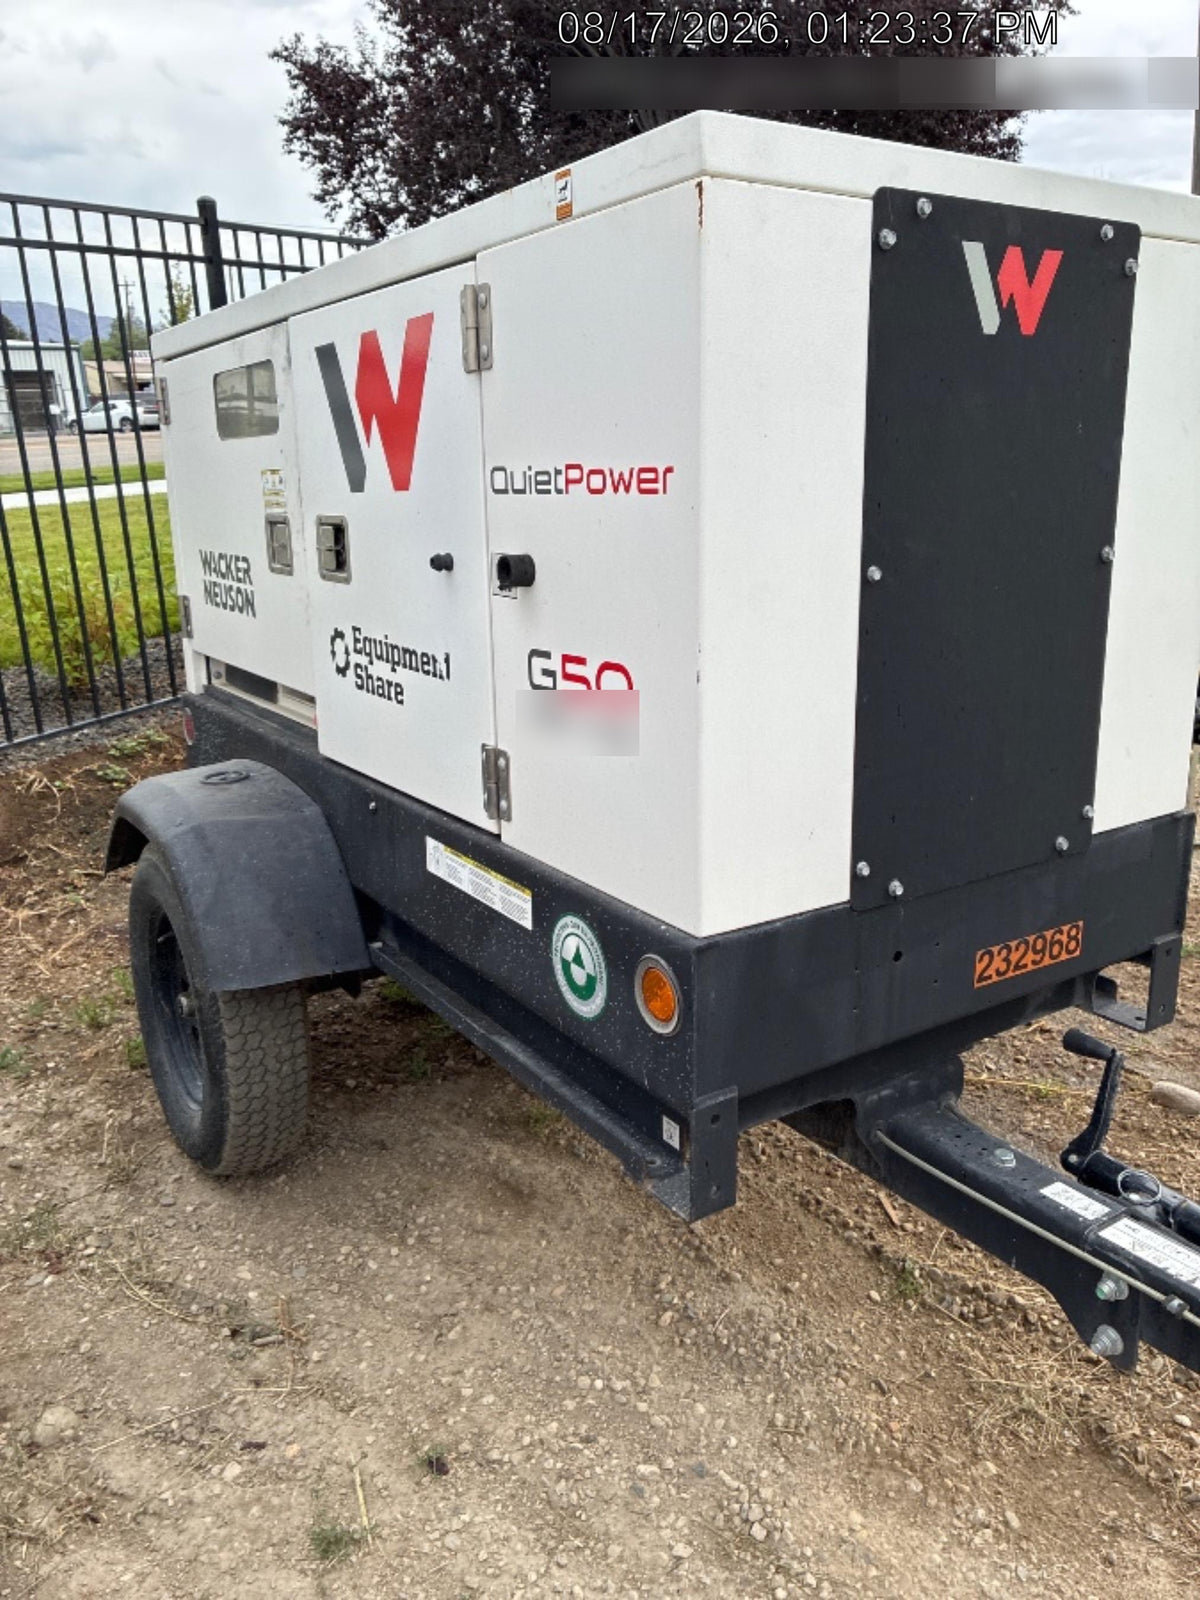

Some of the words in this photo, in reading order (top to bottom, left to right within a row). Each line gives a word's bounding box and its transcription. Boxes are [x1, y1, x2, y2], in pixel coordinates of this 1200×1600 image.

[490, 464, 675, 496] QuietPower
[199, 549, 252, 586] WACKER
[203, 579, 257, 619] NEUSON
[354, 662, 405, 706] Share
[975, 923, 1082, 983] 232968
